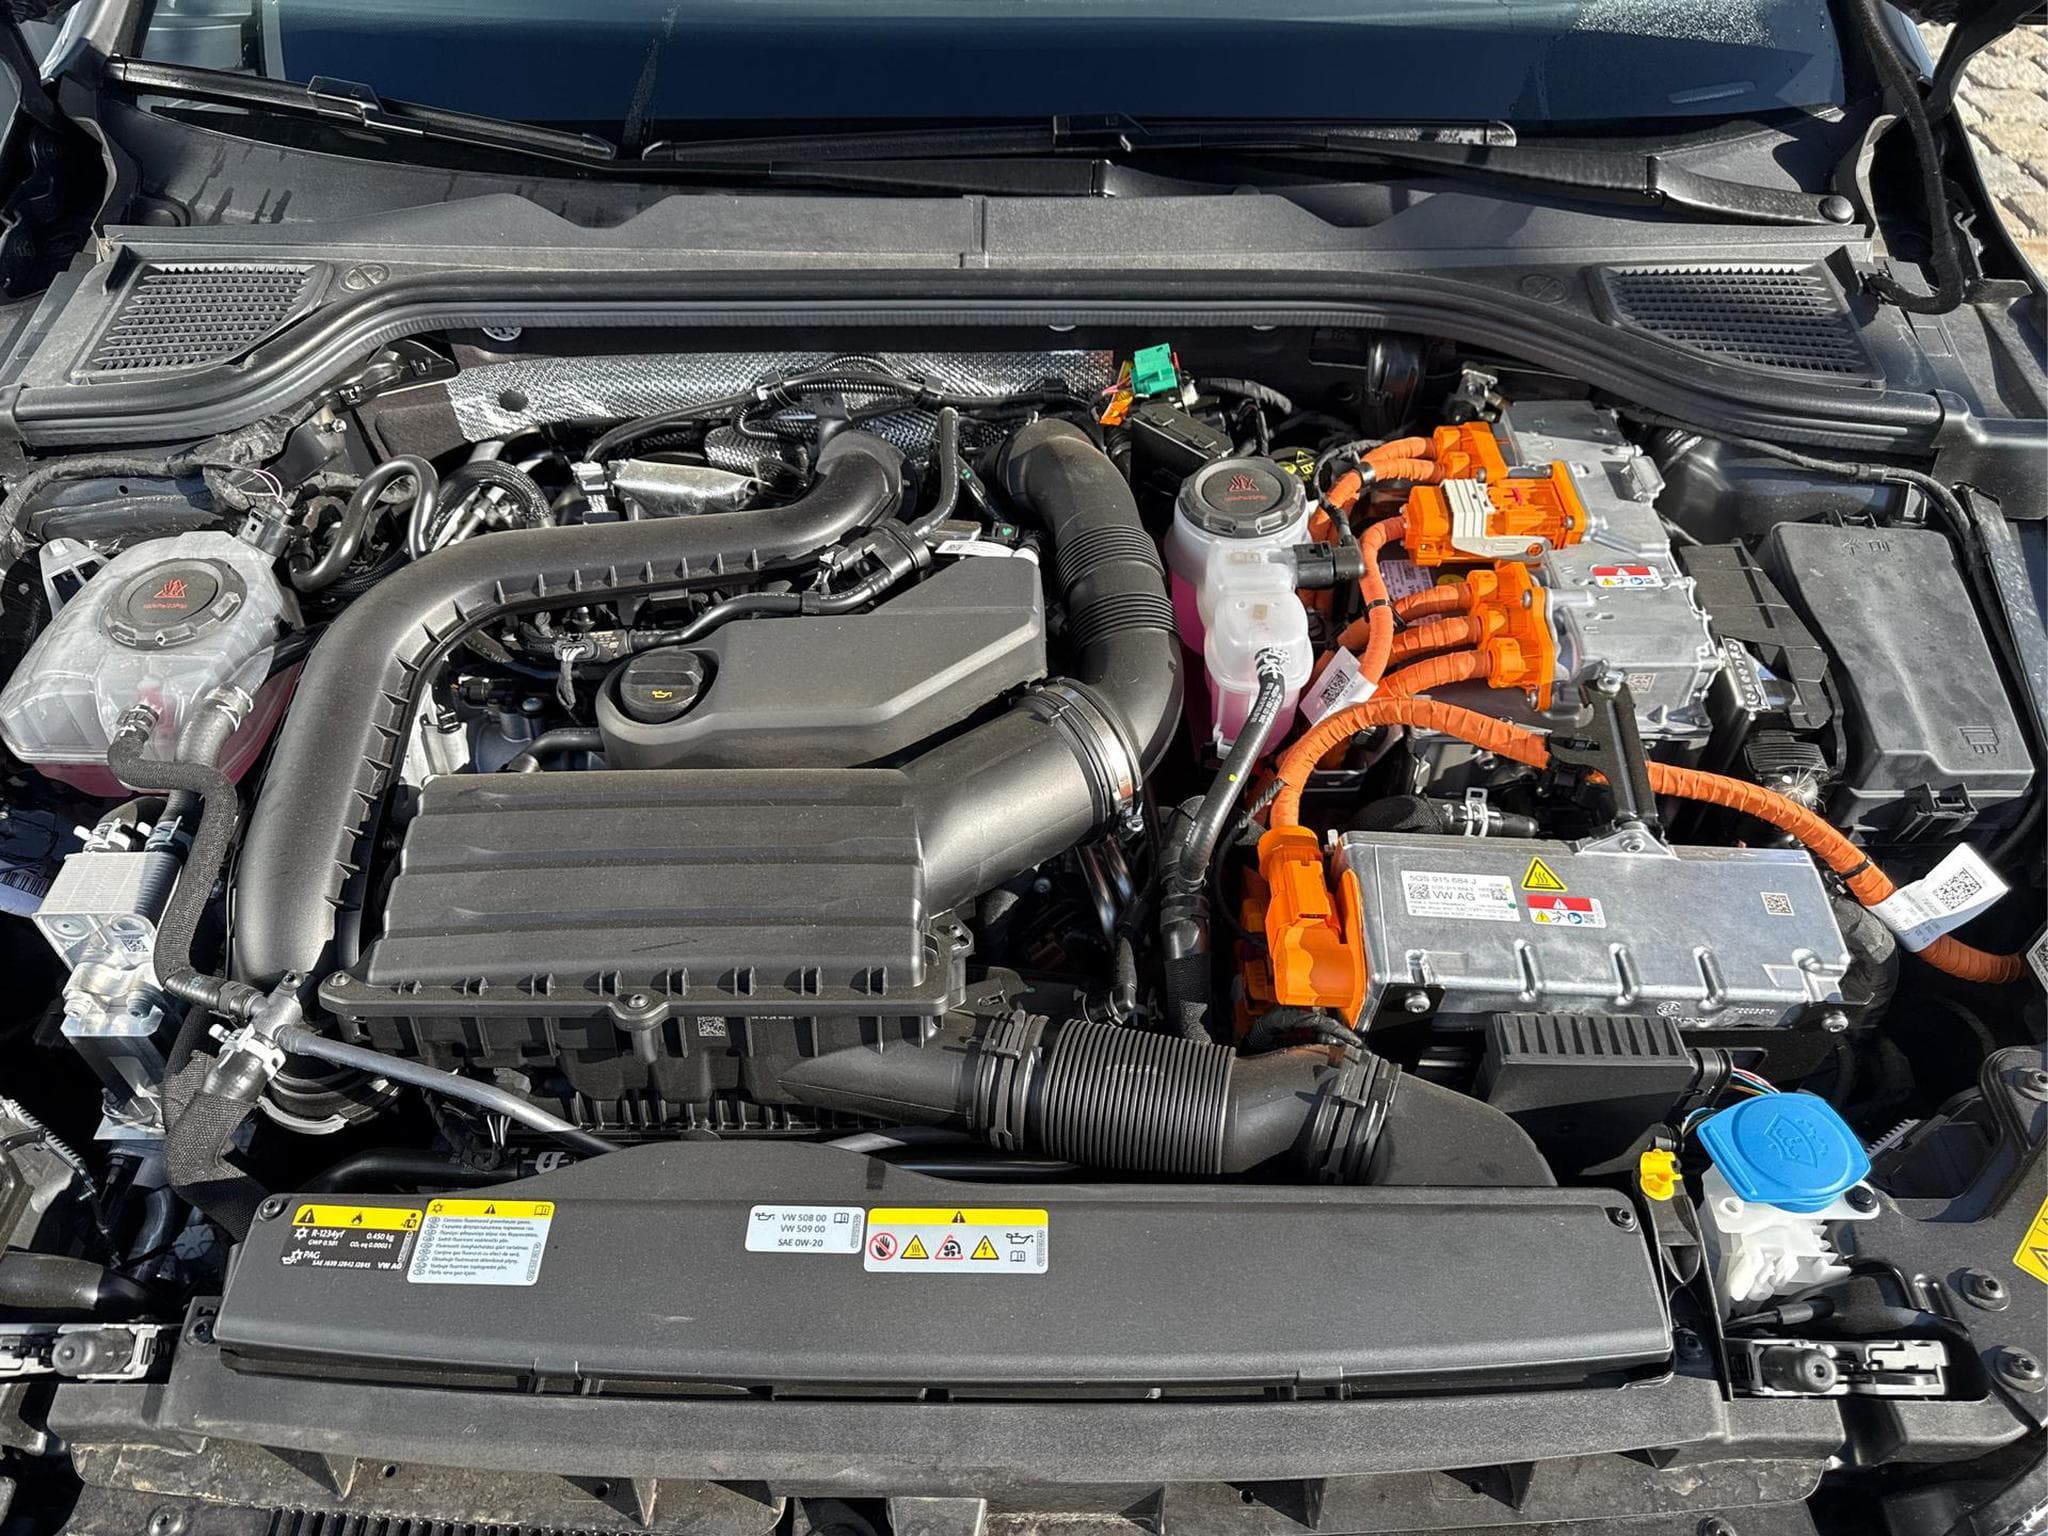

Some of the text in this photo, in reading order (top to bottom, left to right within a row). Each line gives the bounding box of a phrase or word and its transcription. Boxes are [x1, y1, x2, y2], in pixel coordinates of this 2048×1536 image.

[1432, 890, 1453, 900] VW
[1456, 891, 1476, 901] AG
[781, 1213, 828, 1222] VW 508 00
[780, 1224, 826, 1233] VW 509 00
[310, 1229, 395, 1243] R-1234yf 0.450 kg
[778, 1238, 824, 1247] SAE 0W-20
[302, 1250, 321, 1259] PAG
[377, 1261, 390, 1269] VW
